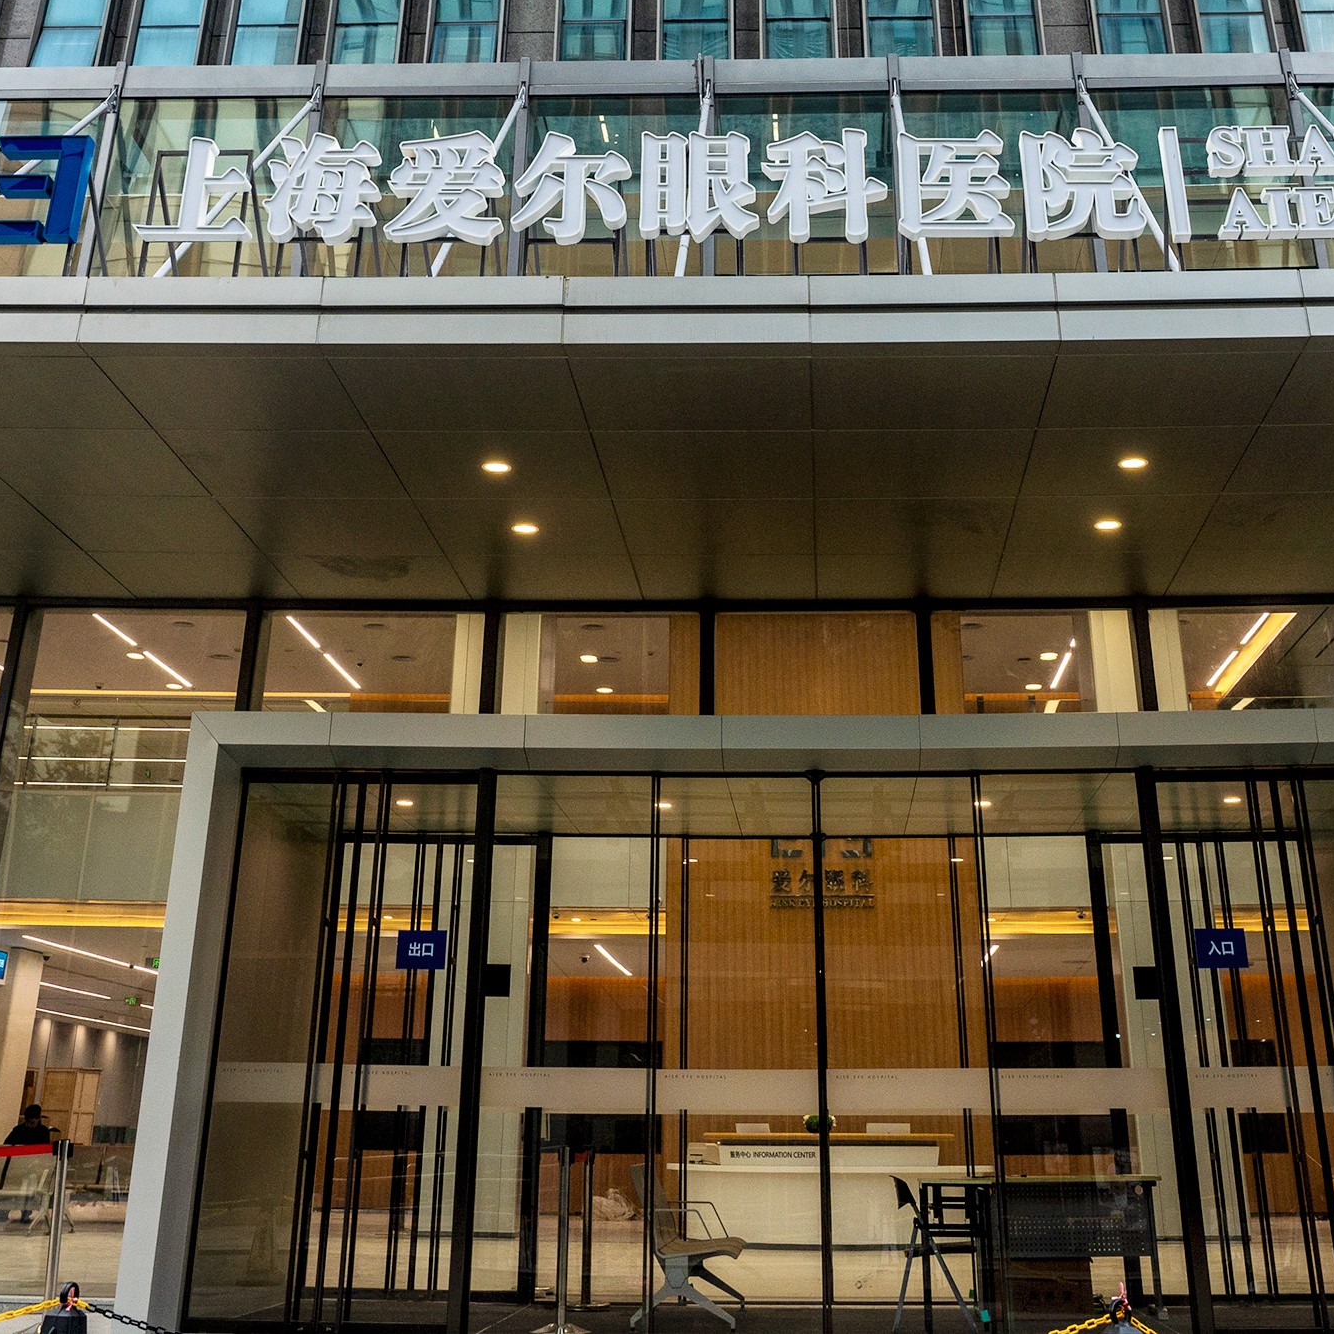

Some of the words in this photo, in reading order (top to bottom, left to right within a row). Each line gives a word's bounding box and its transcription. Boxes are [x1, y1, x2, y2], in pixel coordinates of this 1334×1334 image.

[132, 128, 1148, 246] 上海爱尔眼科医院
[408, 942, 434, 957] 出口
[1208, 940, 1234, 956] 入口
[753, 1151, 793, 1159] INFORMATION
